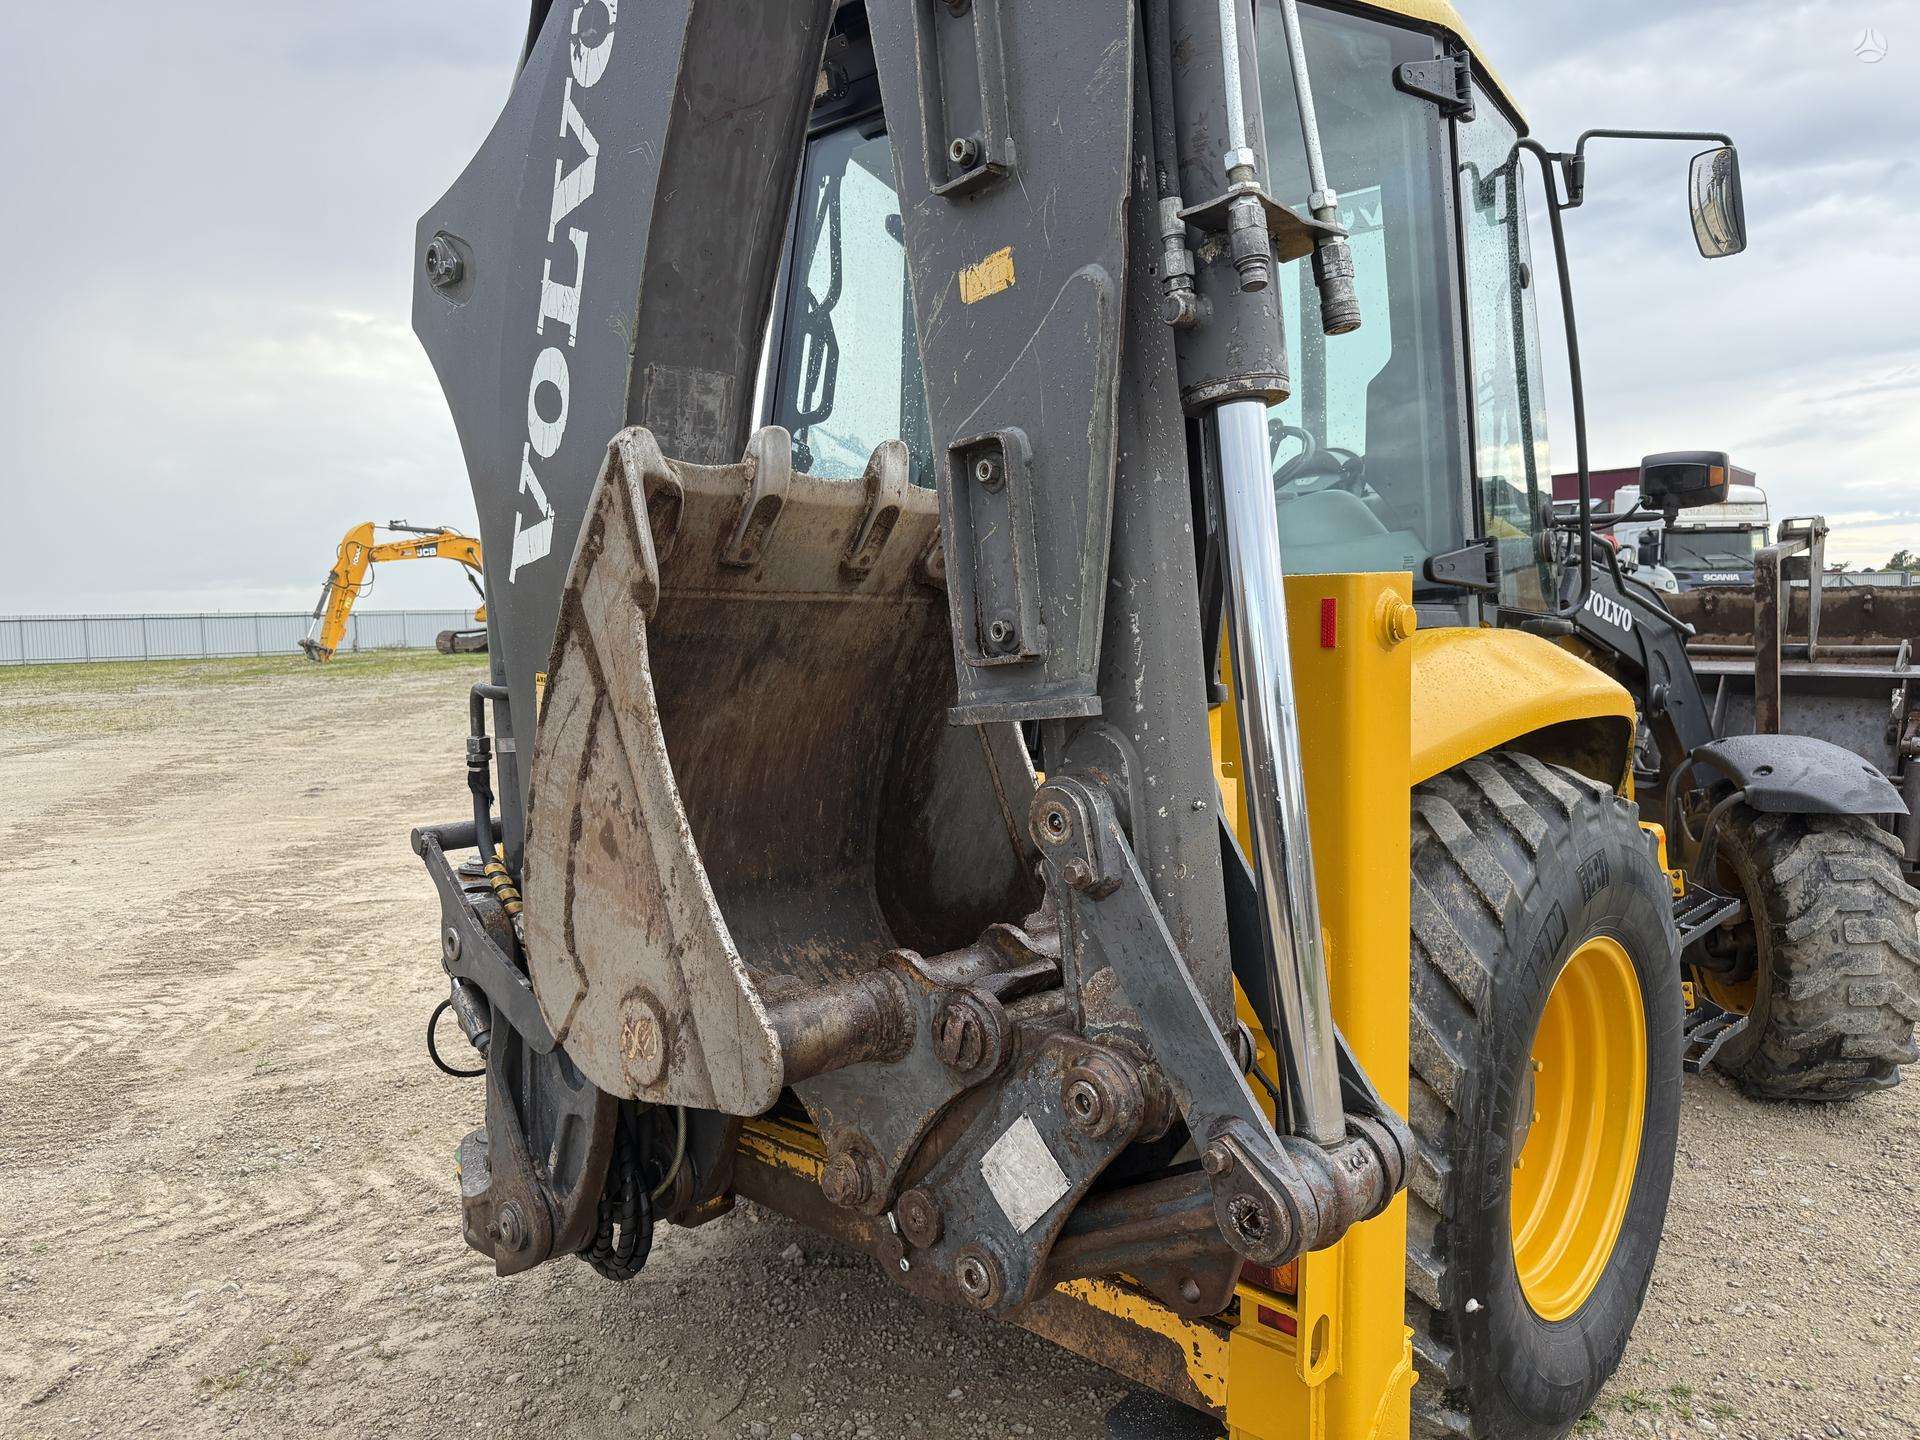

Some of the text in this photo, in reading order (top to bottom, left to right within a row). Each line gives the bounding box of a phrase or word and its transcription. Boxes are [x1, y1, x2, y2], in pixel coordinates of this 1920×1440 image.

[508, 0, 619, 584] VOLVO
[416, 547, 437, 557] JCB
[1702, 573, 1740, 581] SCANIA
[1584, 589, 1632, 632] VOLVO
